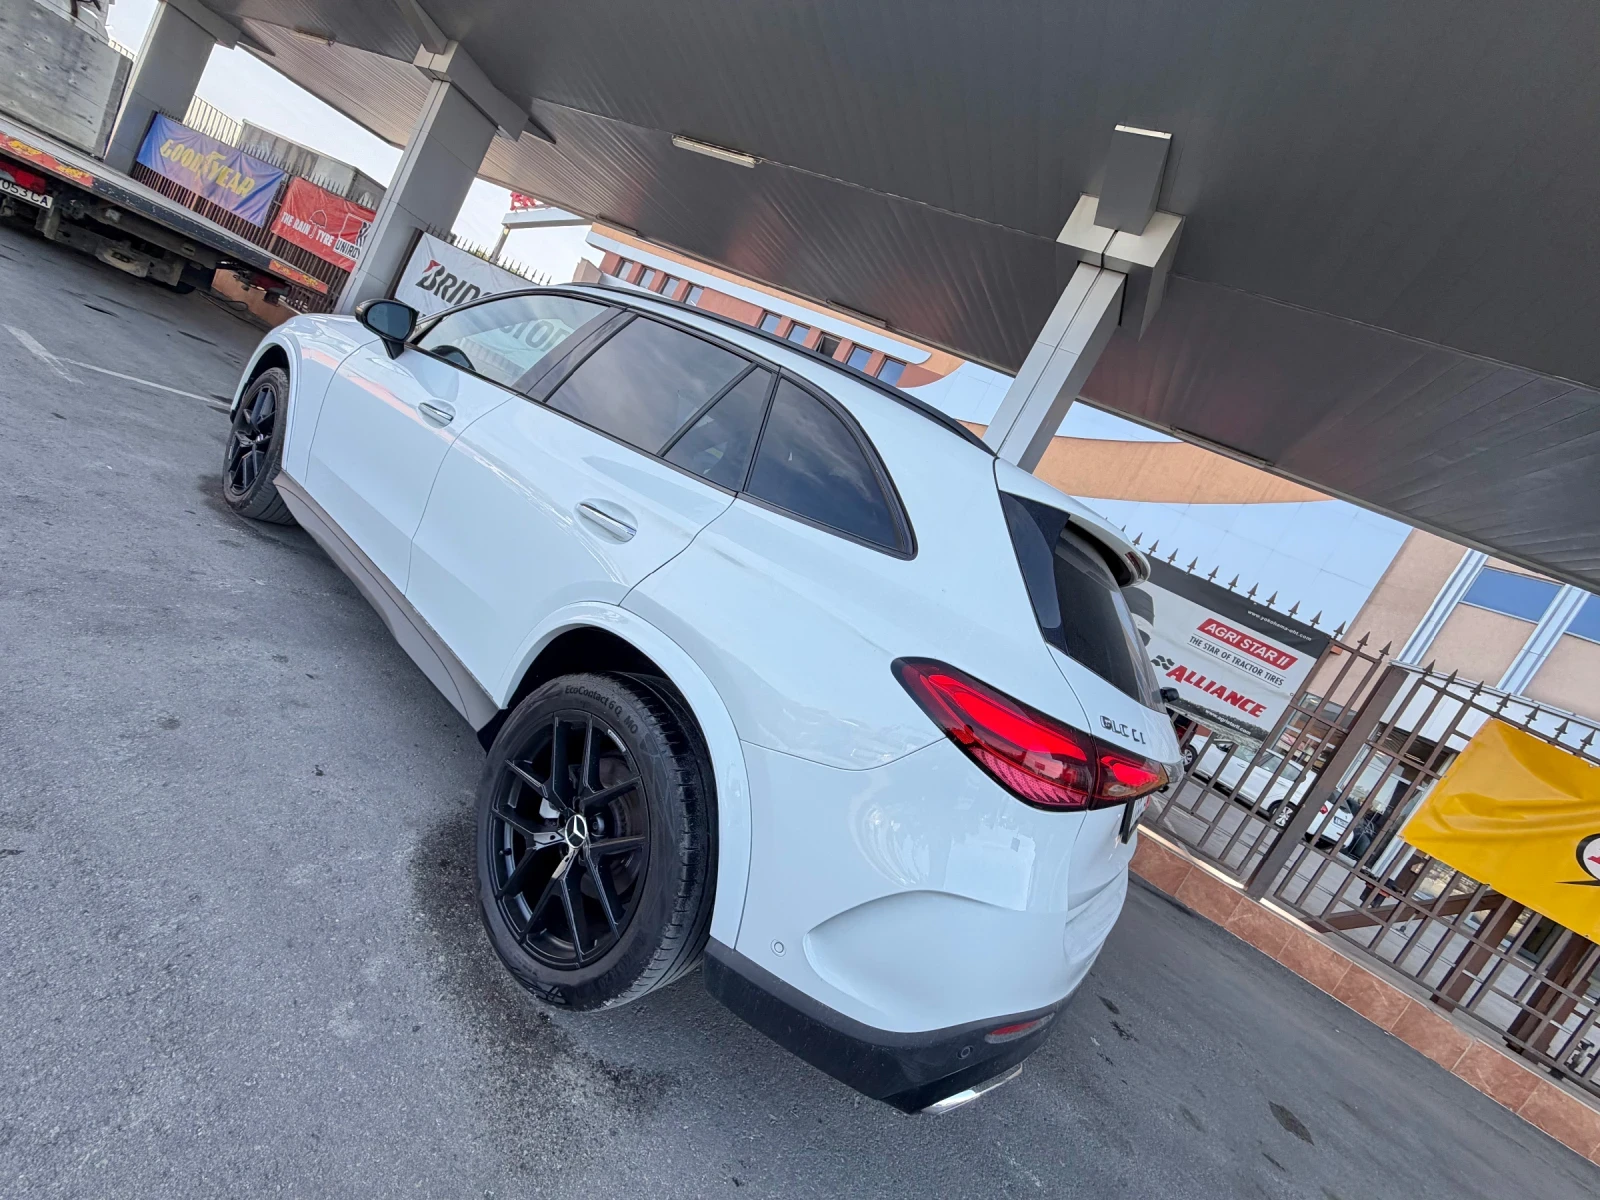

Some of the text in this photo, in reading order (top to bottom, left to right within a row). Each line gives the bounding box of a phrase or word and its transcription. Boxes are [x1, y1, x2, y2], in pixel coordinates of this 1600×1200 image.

[160, 138, 256, 198] GOODYEAR
[281, 211, 335, 247] THE RAIN TYRE
[415, 259, 493, 306] BRID
[1189, 636, 1285, 687] THE STAR OF TRACTOR TIRES
[1204, 623, 1291, 667] AGRI STAR II
[565, 685, 610, 706] EcoContact
[608, 700, 617, 710] 6
[623, 715, 639, 734] MO
[1165, 664, 1267, 718] ALLIANCE
[1099, 715, 1130, 738] GLC
